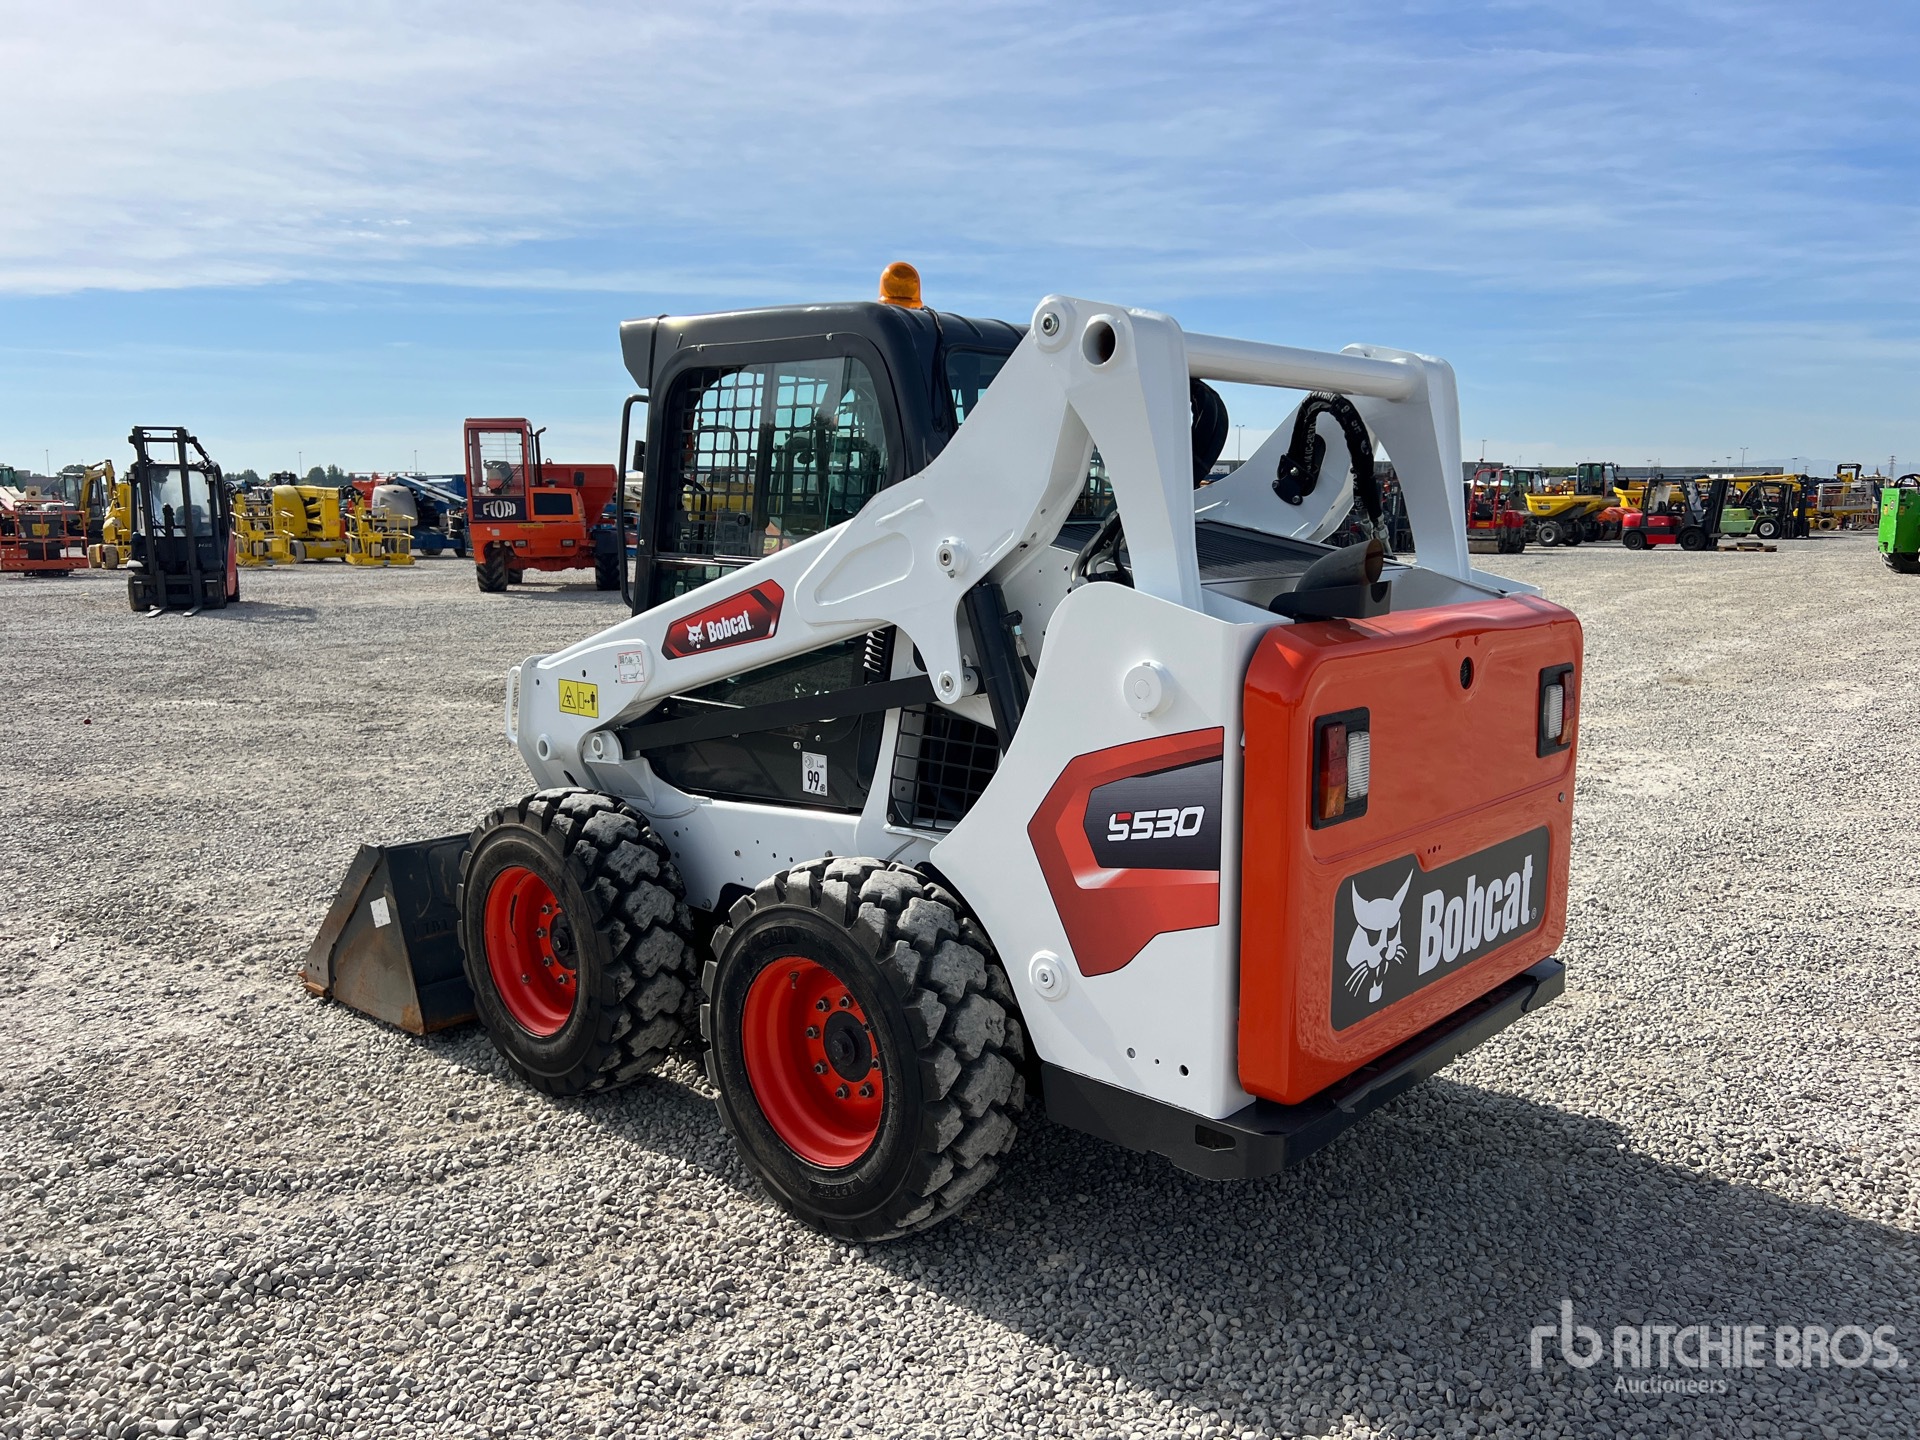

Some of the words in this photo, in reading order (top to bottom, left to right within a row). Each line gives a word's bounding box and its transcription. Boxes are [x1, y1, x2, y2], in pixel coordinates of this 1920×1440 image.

[706, 610, 752, 643] Bobcat
[807, 769, 820, 791] 99
[1107, 805, 1206, 842] S530
[1418, 854, 1533, 976] Bobcat
